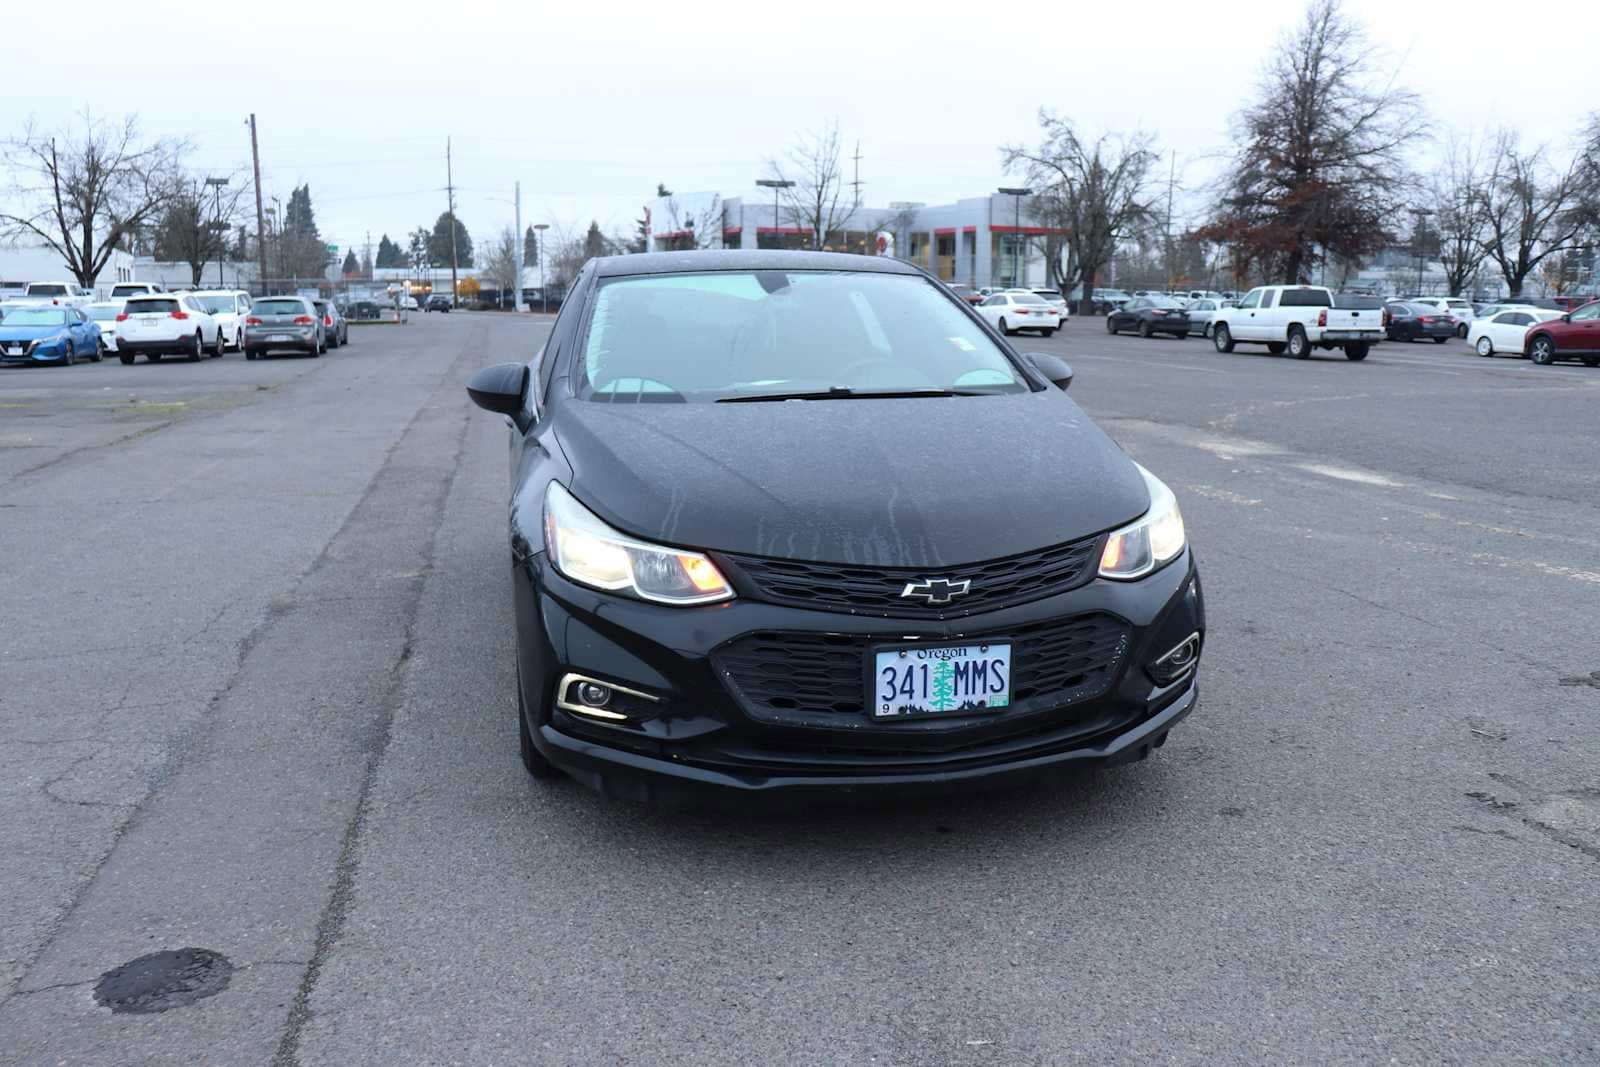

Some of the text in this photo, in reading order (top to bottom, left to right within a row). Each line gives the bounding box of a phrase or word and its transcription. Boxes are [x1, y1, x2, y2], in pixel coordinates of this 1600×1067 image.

[917, 648, 967, 661] Oregon
[881, 659, 1005, 701] 341 MMS
[882, 704, 890, 713] 9
